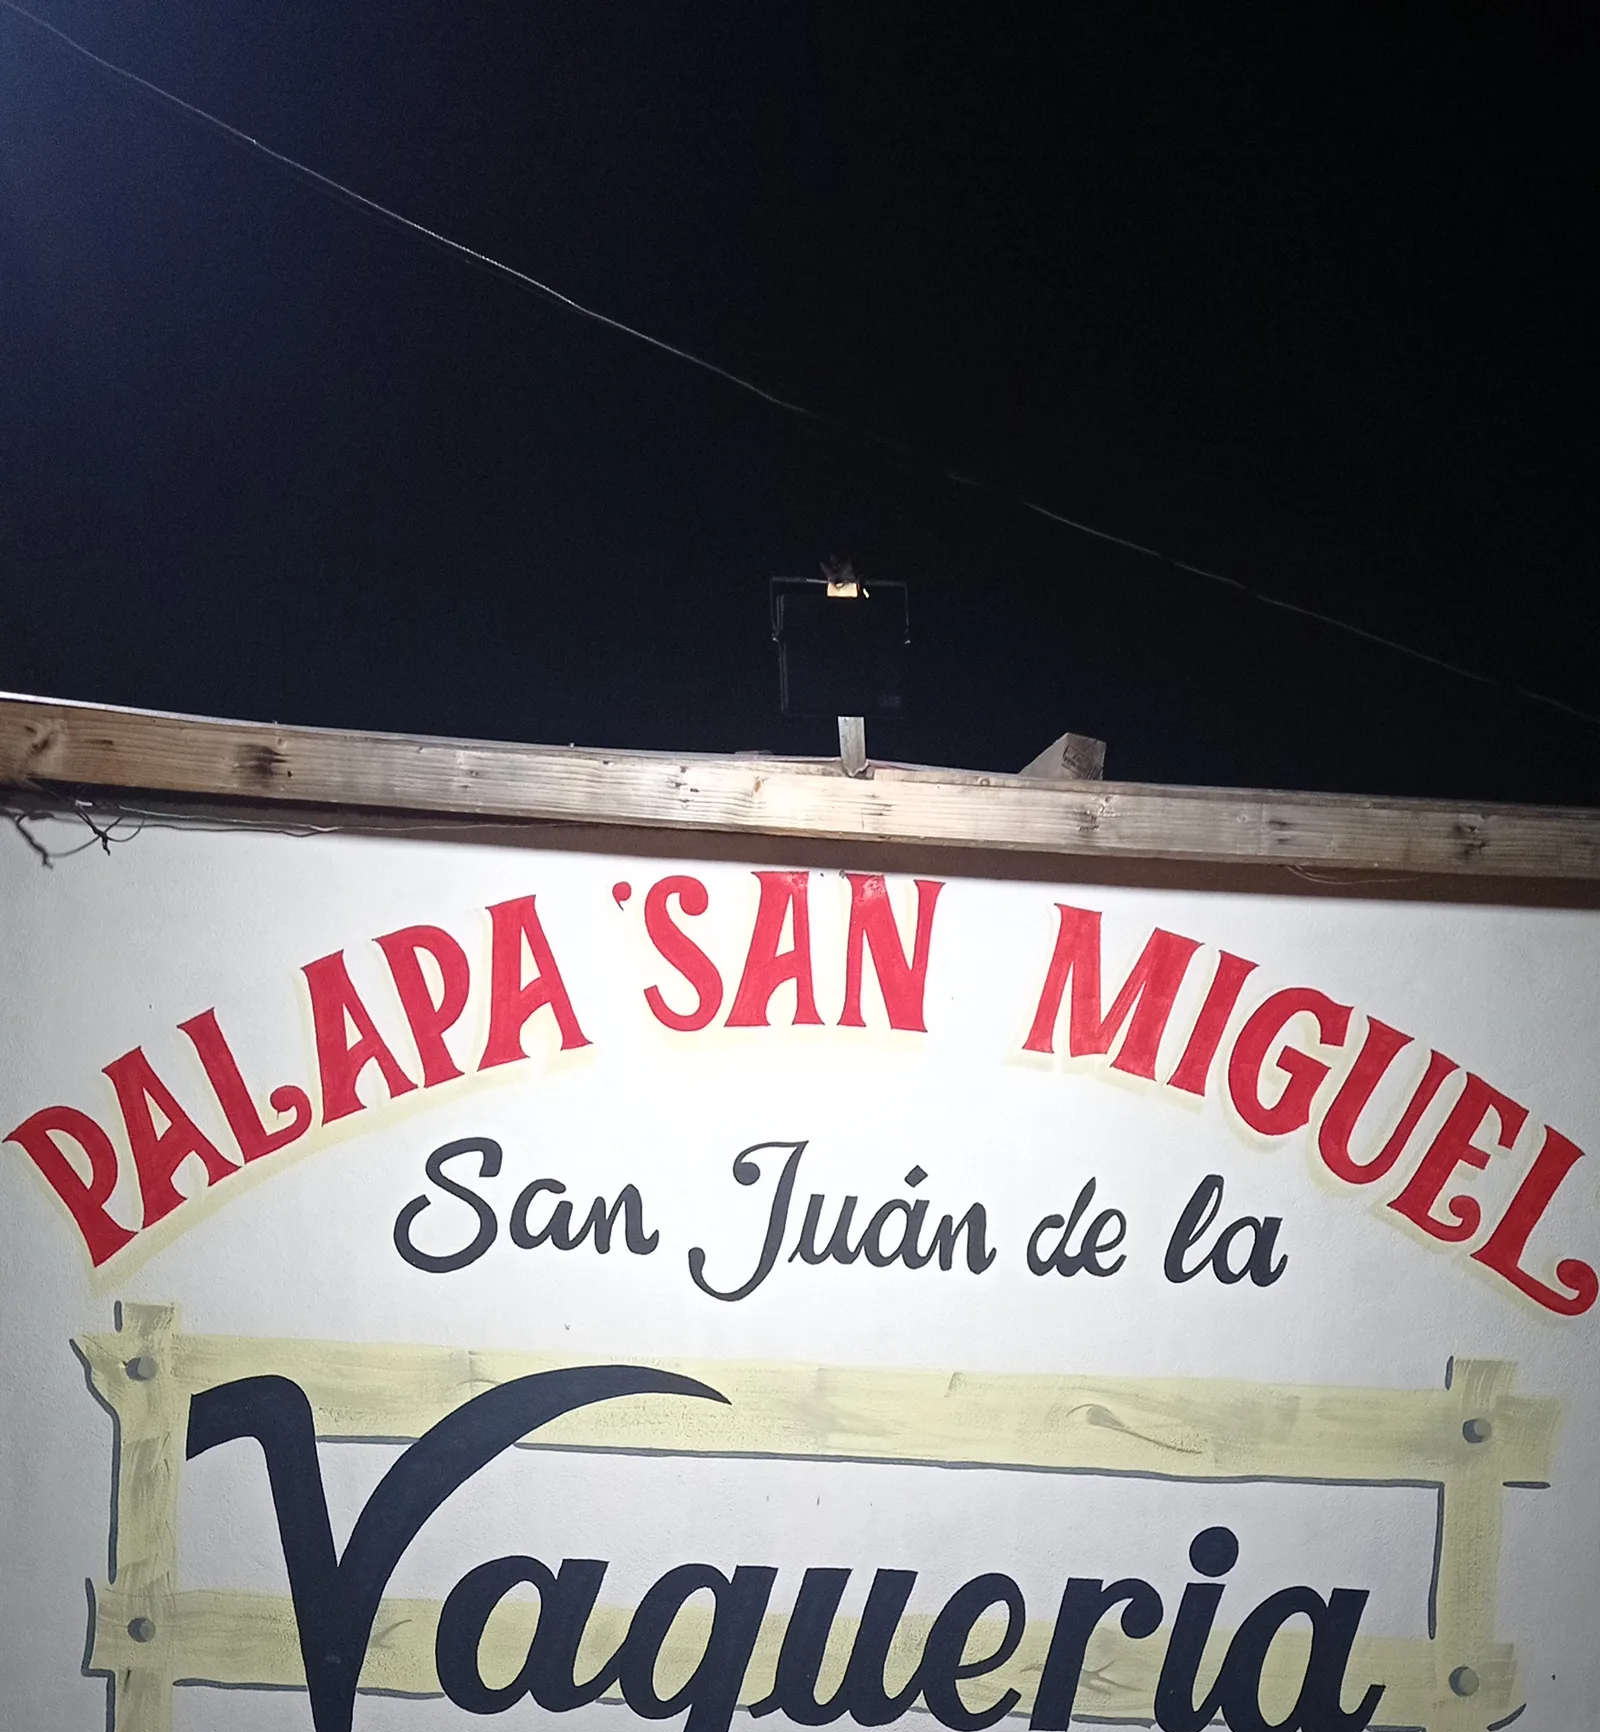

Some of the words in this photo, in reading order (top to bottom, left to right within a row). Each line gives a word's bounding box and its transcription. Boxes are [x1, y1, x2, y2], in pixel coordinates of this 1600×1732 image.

[3, 894, 593, 1268] PALAPA
[1022, 903, 1600, 1316] MIGUEL
[393, 1136, 660, 1274] San
[1026, 1176, 1128, 1278] de
[1163, 1174, 1289, 1288] la
